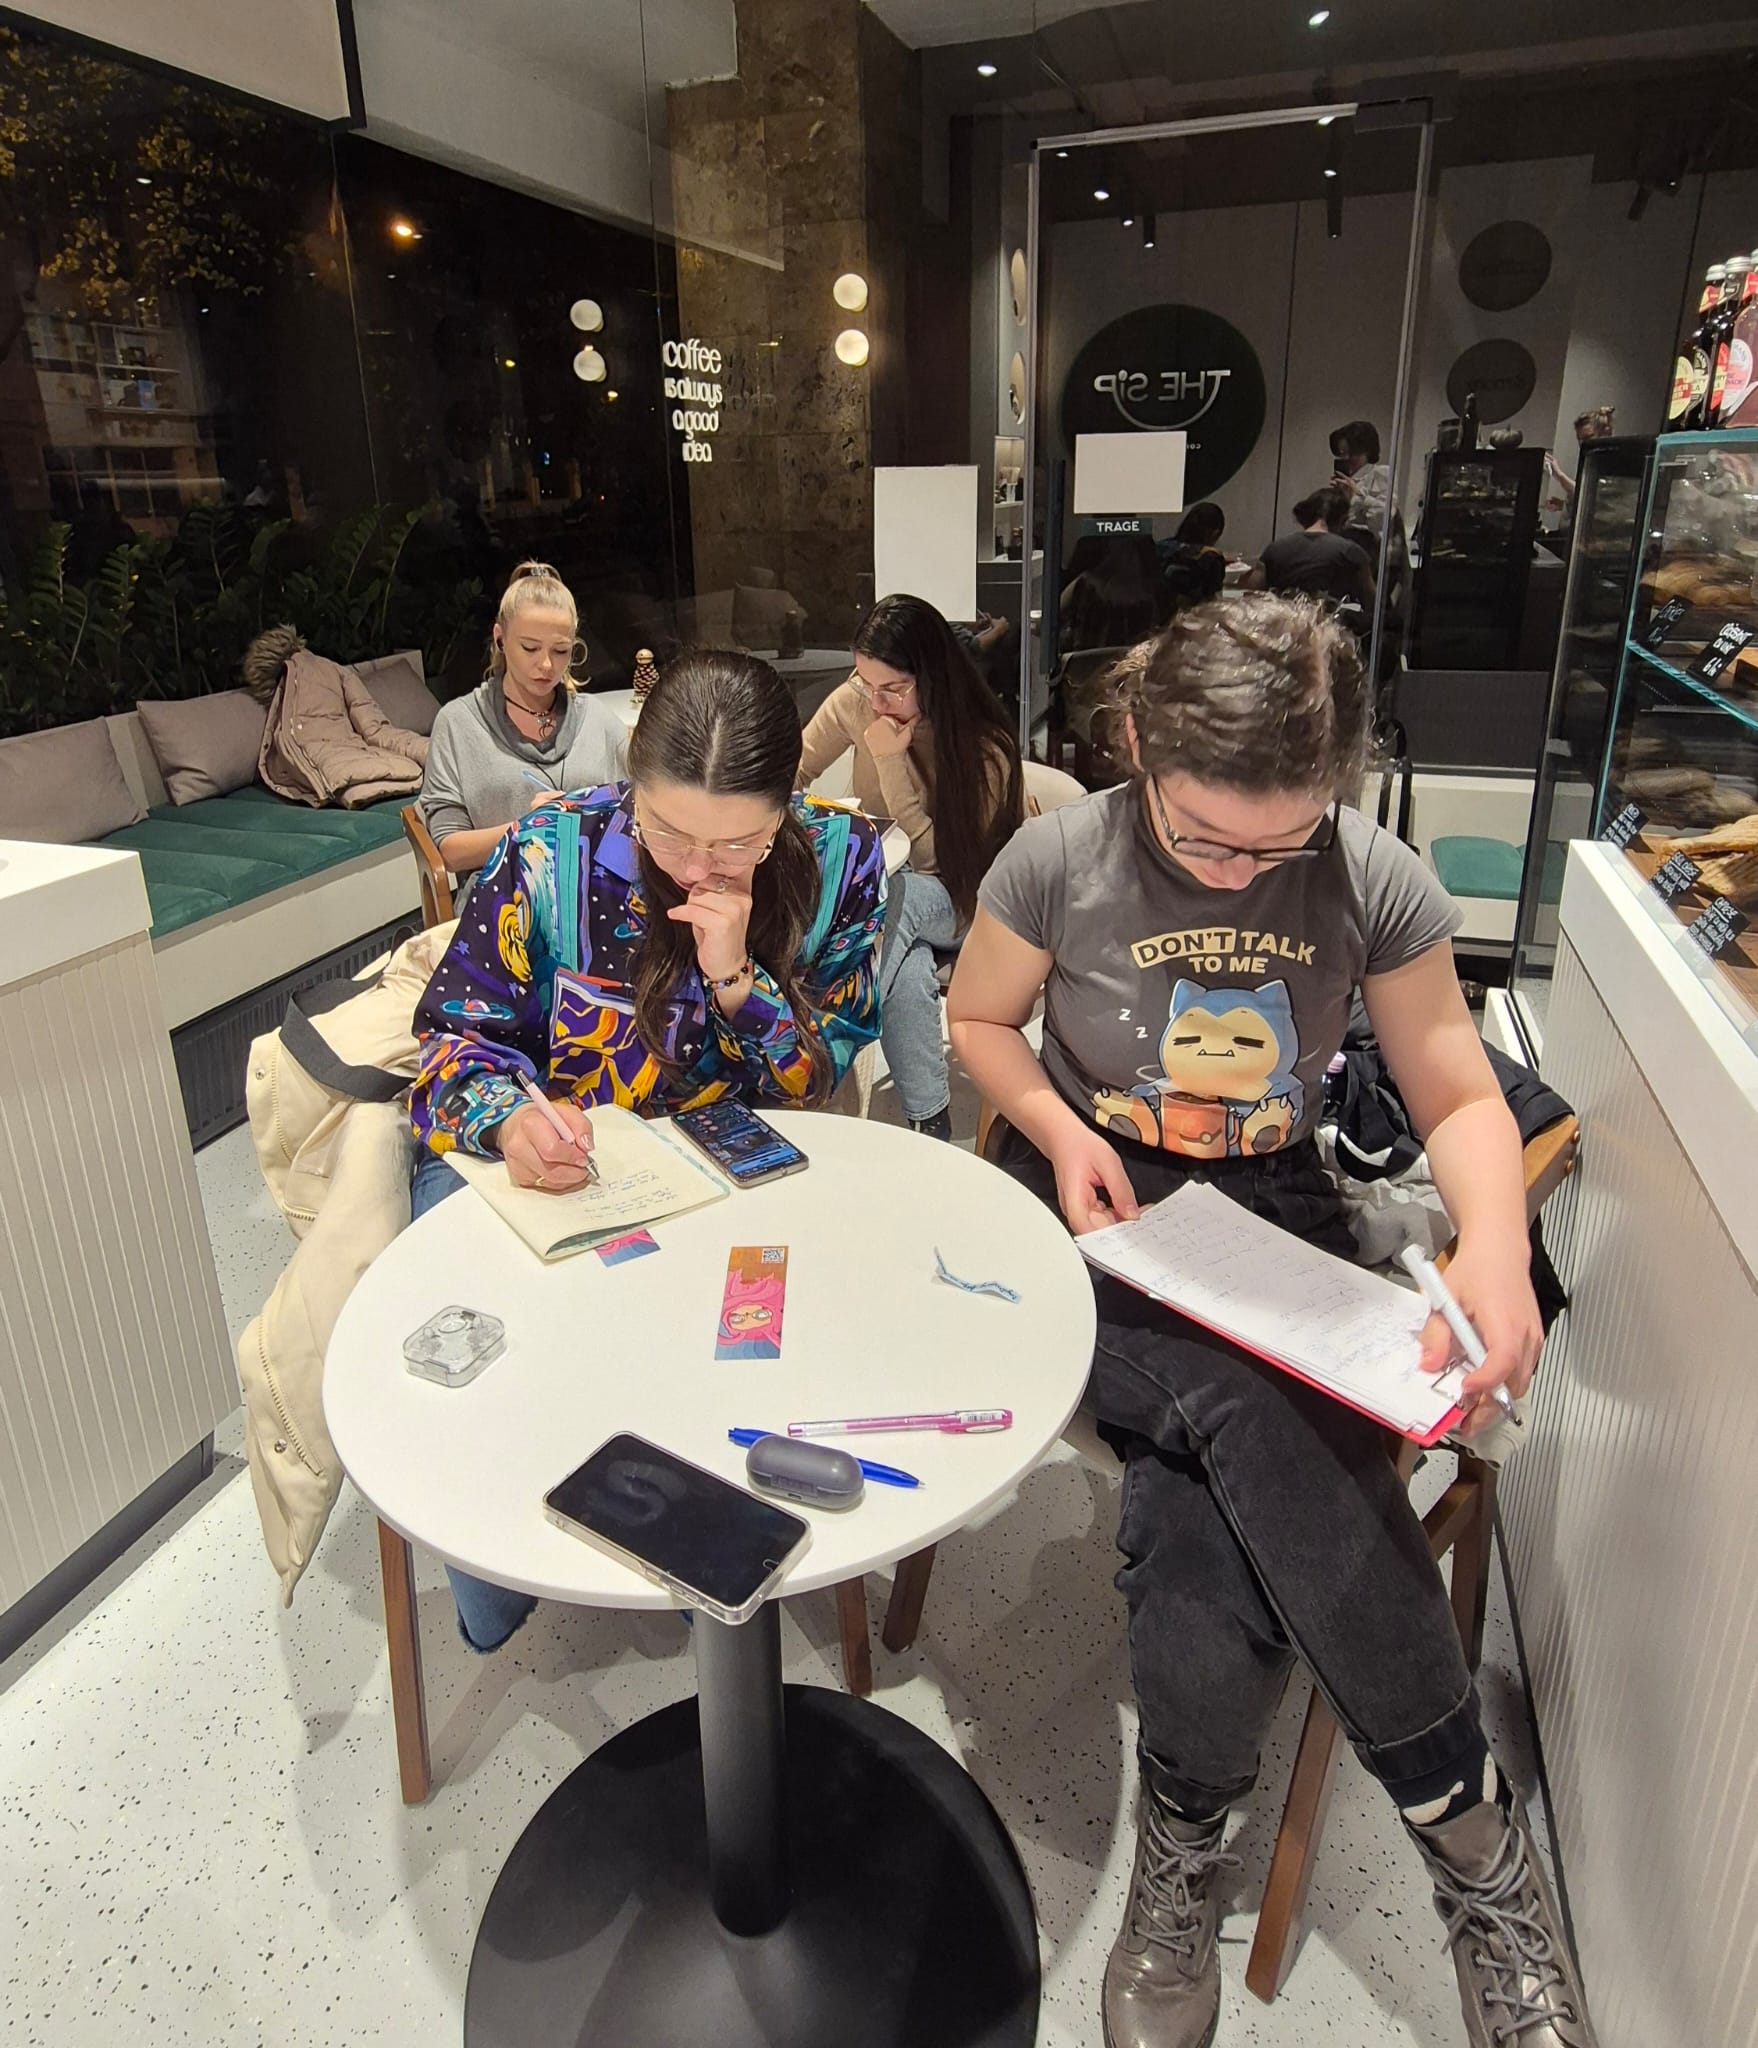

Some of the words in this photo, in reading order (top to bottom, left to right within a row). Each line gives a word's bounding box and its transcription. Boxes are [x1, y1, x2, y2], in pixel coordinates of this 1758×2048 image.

[677, 377, 723, 409] always
[672, 409, 685, 431] a
[684, 410, 719, 440] good
[682, 440, 713, 462] idea
[1096, 521, 1140, 533] TRAGE
[1136, 931, 1234, 965] DON'T
[1241, 931, 1317, 966] TALK
[1189, 957, 1223, 973] TO
[1229, 956, 1270, 974] ME
